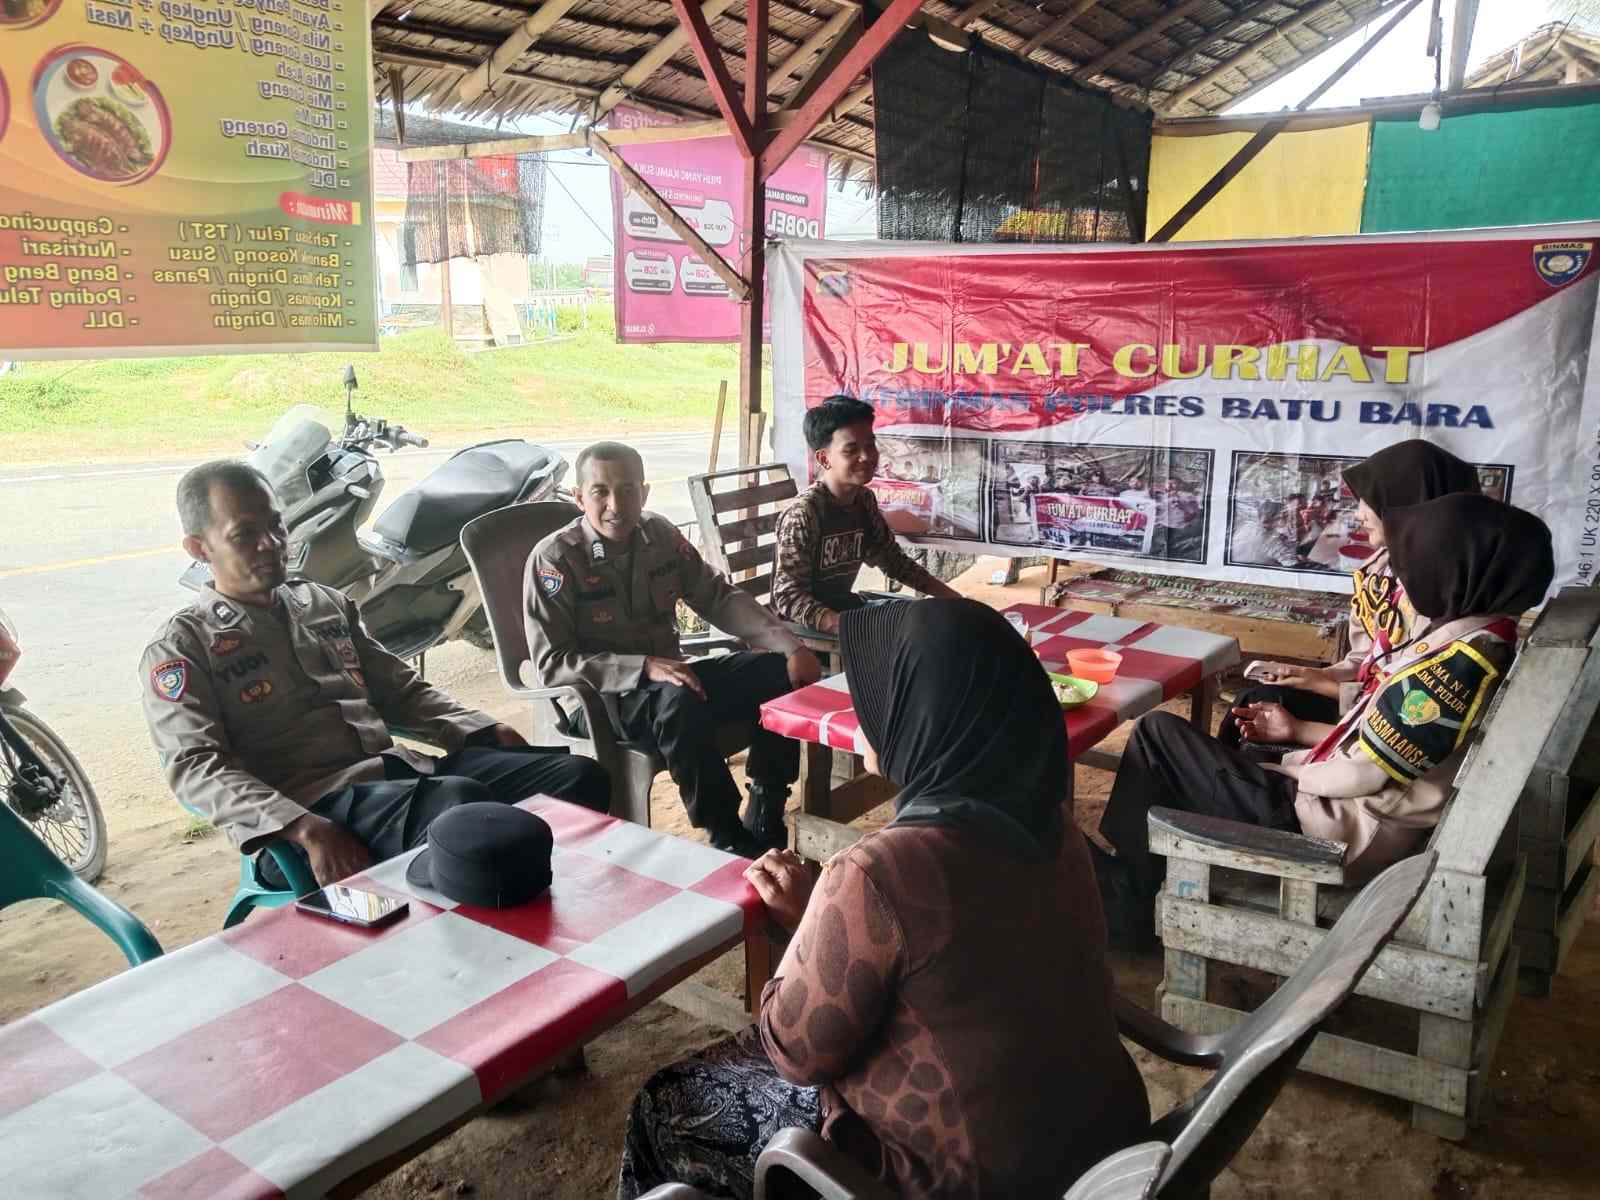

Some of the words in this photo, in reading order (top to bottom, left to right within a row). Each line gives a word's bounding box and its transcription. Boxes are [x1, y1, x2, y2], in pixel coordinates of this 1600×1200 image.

[1541, 241, 1585, 250] BINMAS
[883, 341, 1091, 377] JUM'AT
[1112, 341, 1425, 384] CURHAT
[1221, 396, 1342, 422] BATU
[1359, 400, 1495, 430] BARA
[1047, 502, 1083, 519] JUM'AT
[1086, 504, 1135, 526] CURHAT
[1585, 498, 1600, 523] 220
[1580, 527, 1598, 546] UK
[1430, 663, 1451, 686] SMA
